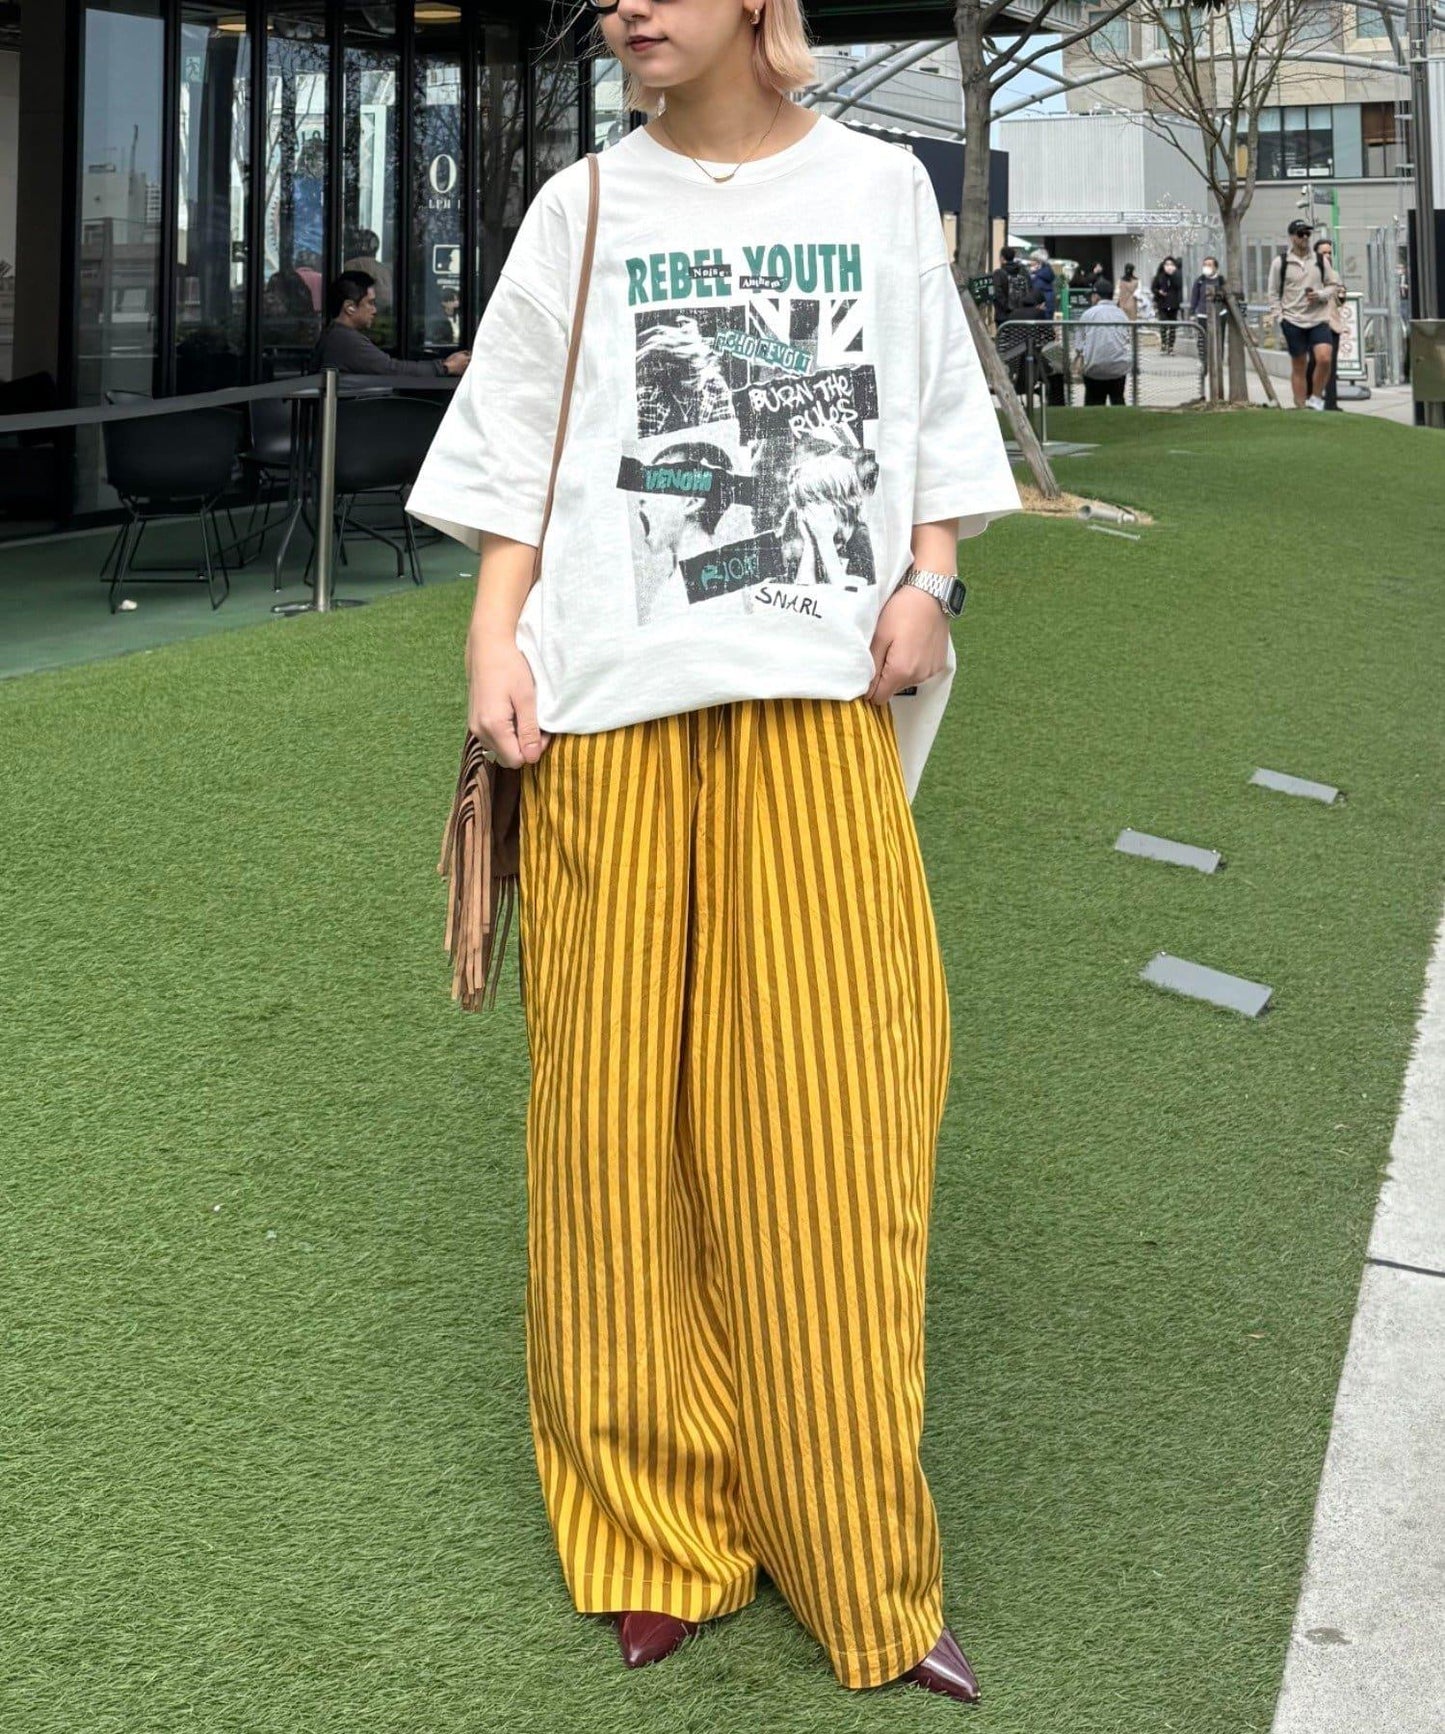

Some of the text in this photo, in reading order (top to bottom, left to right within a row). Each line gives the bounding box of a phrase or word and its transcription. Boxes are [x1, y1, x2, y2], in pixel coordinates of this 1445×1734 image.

[625, 243, 862, 306] REBEL YOUTH
[693, 268, 725, 278] Noise
[742, 276, 781, 289] Anthem
[748, 381, 814, 413] BURN
[645, 468, 713, 492] VENOM
[755, 586, 823, 619] SNARL
